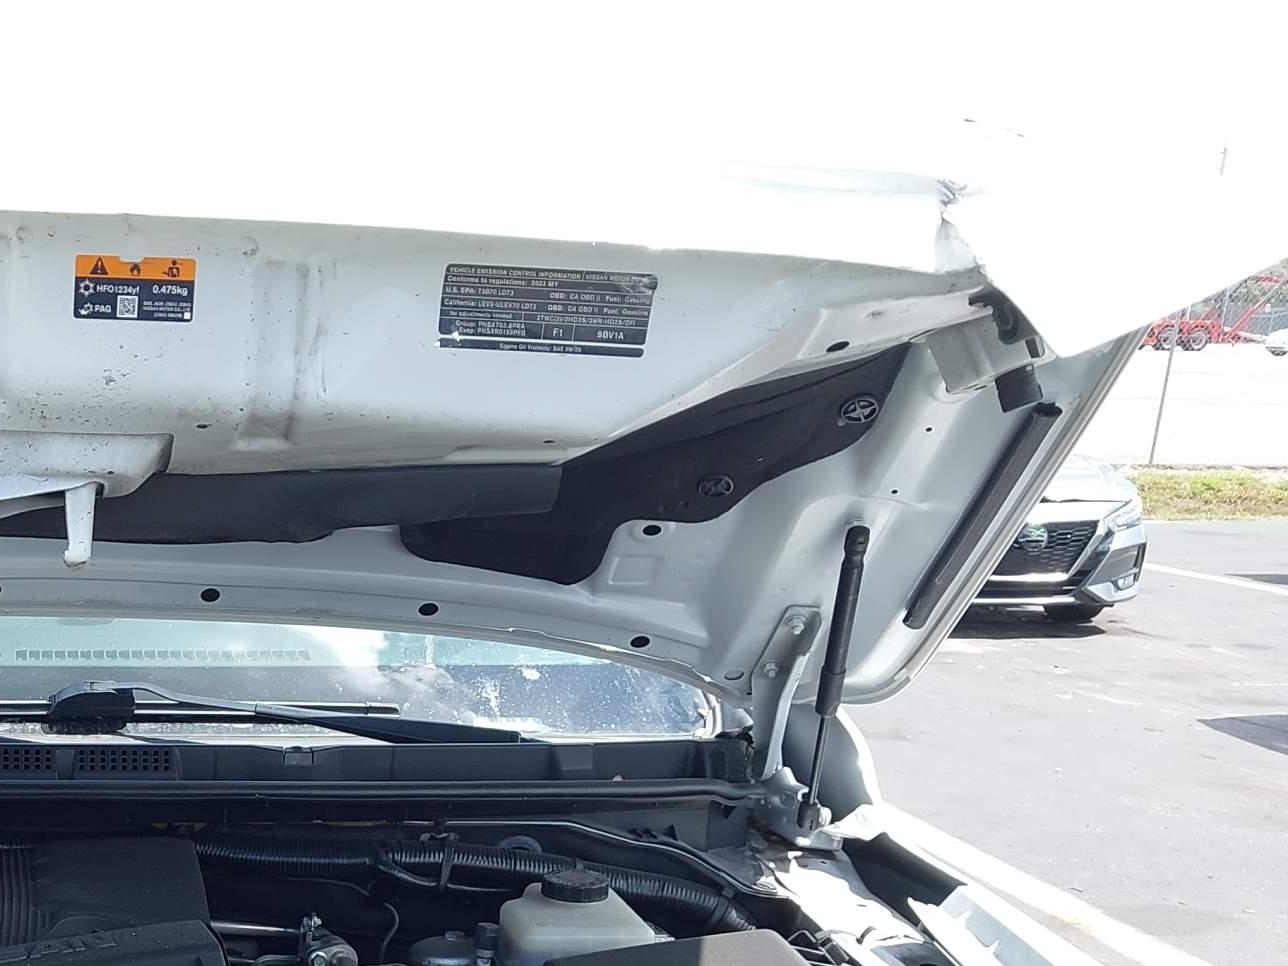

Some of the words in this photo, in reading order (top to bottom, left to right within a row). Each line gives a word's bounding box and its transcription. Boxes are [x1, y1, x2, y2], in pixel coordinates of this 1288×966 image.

[538, 270, 581, 280] INFORMATION
[489, 278, 528, 286] regulations:
[96, 284, 140, 295] HFO1234yf
[152, 284, 188, 296] 0.475kg
[444, 298, 476, 306] California:
[94, 304, 112, 313] PAG
[552, 328, 563, 337] F1
